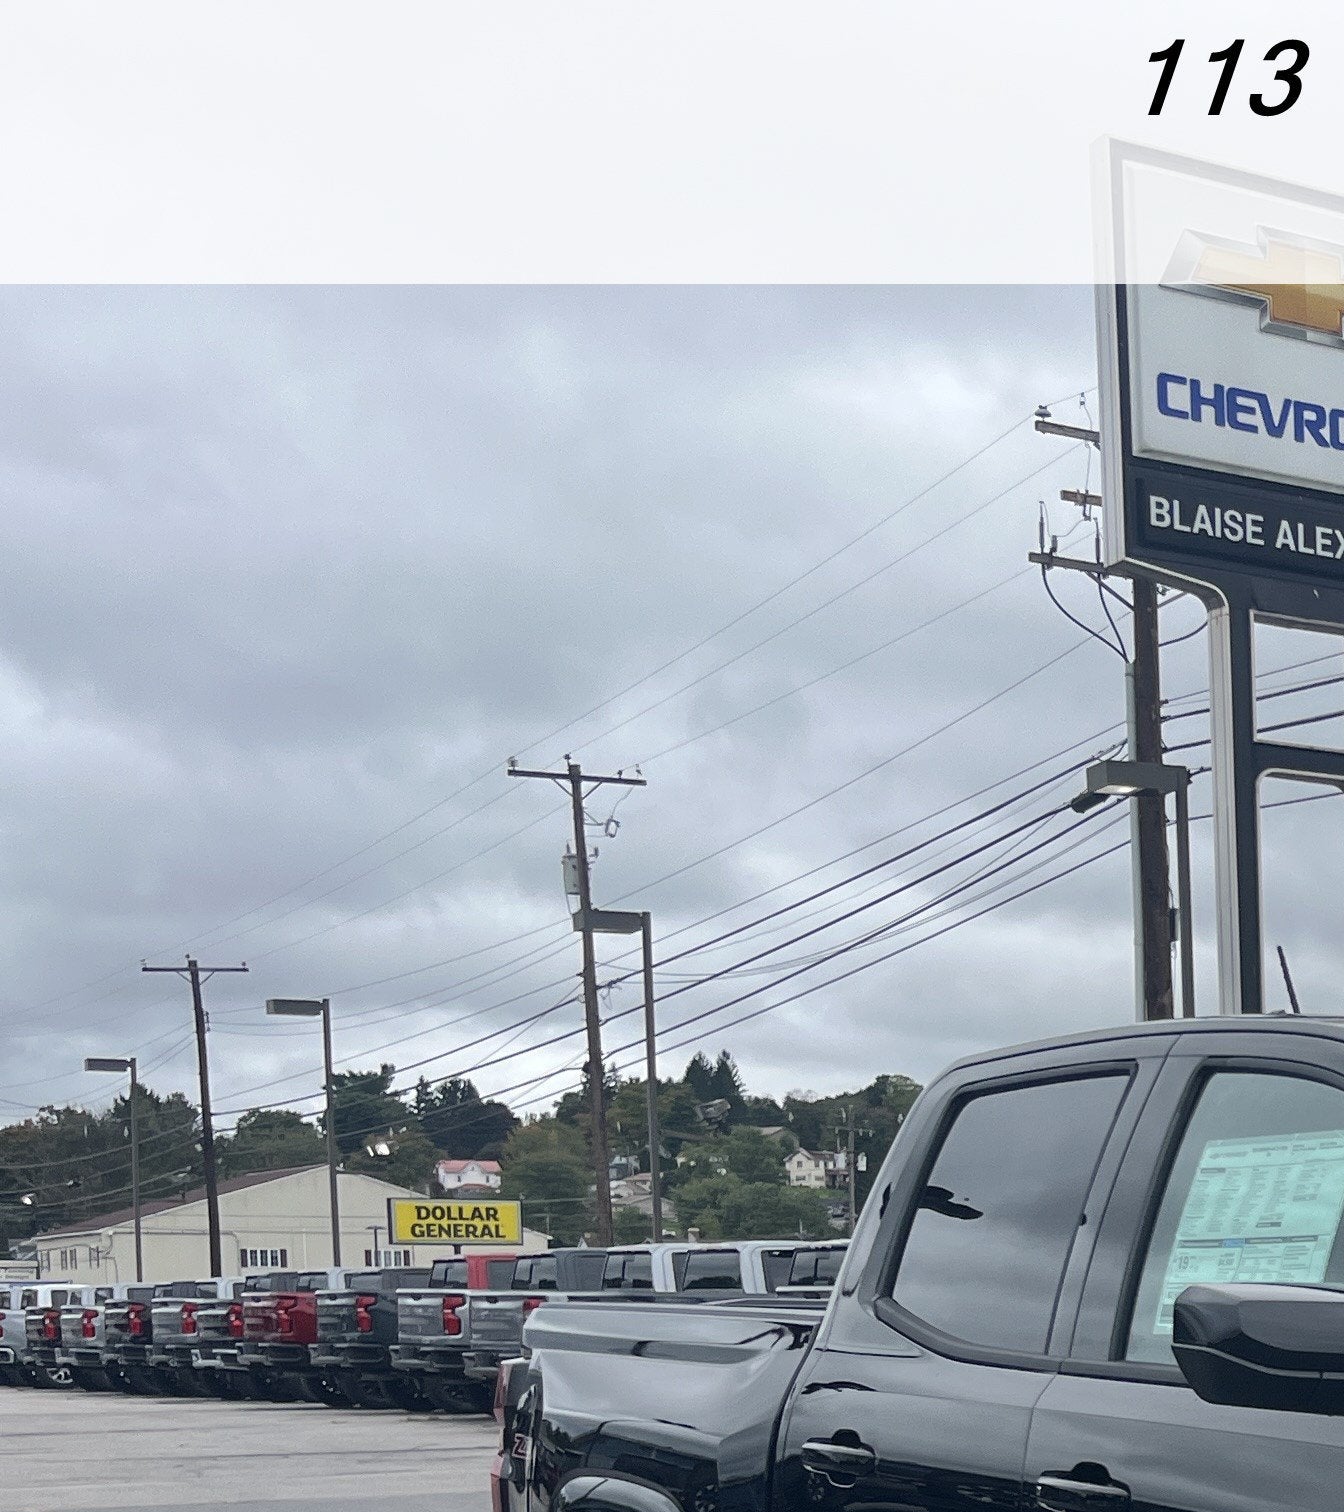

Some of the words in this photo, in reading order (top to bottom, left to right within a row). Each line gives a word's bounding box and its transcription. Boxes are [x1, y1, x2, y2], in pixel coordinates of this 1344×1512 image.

[1149, 494, 1265, 546] BLAISE
[414, 1205, 499, 1222] DOLLAR
[410, 1223, 507, 1239] GENERAL
